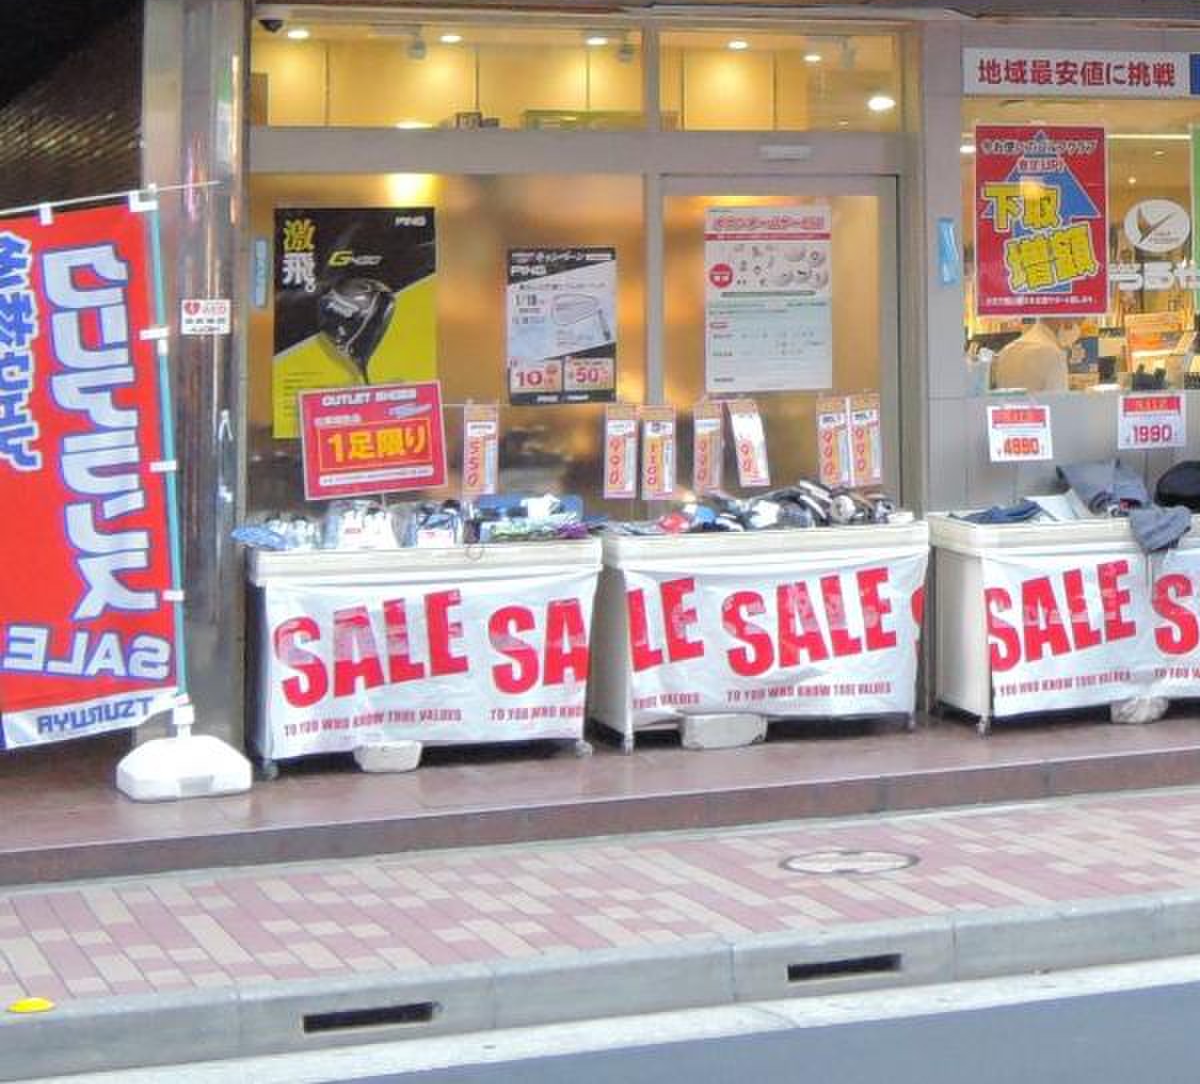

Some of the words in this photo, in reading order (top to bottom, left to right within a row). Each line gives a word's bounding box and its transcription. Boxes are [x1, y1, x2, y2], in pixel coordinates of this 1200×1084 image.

[978, 58, 1176, 88] 地域最安値に挑戦
[982, 181, 1061, 233] 下取
[273, 588, 469, 709] SALE
[721, 566, 898, 678] SALE
[983, 558, 1137, 673] SALE
